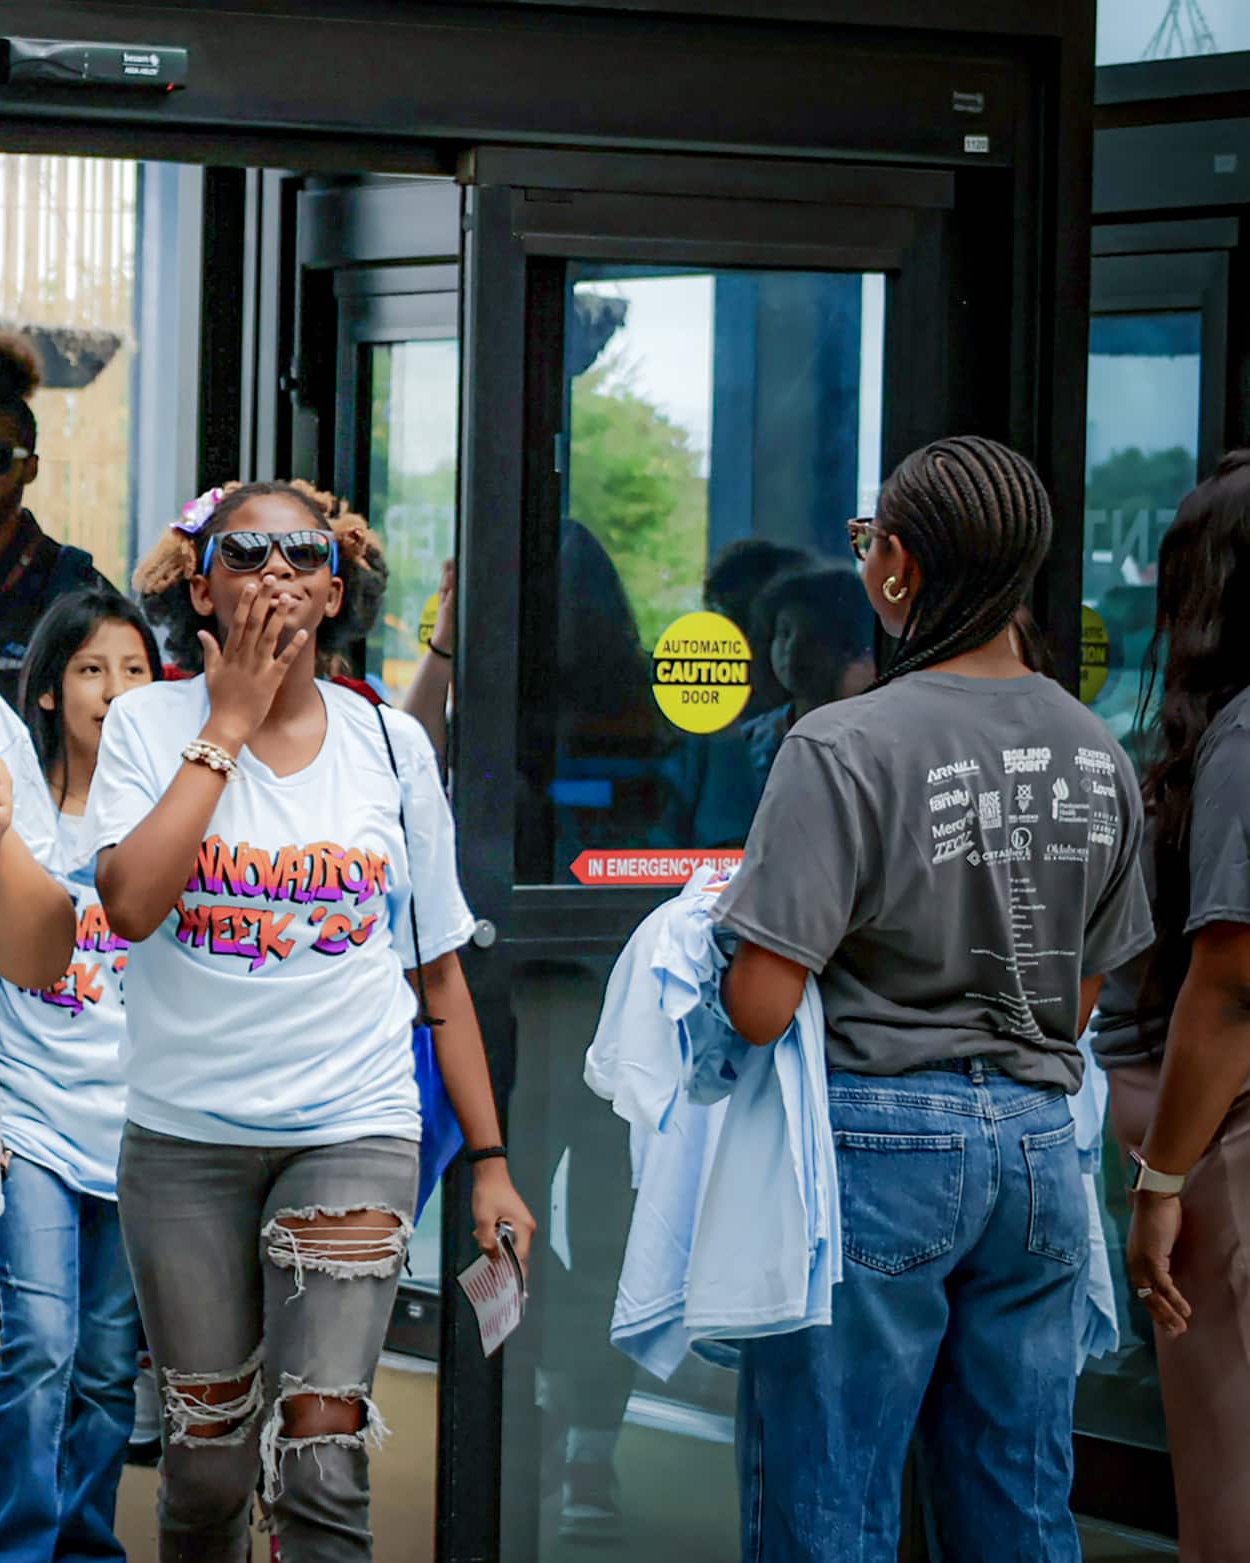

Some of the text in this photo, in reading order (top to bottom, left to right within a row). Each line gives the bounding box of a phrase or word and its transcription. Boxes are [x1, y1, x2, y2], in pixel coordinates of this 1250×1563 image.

[662, 640, 741, 654] AUTOMATIC
[656, 661, 748, 684] CAUTION
[681, 690, 720, 704] DOOR
[929, 789, 970, 813] family
[588, 858, 604, 876] IN
[607, 858, 699, 877] EMERGENCY
[174, 899, 296, 973] WEEK
